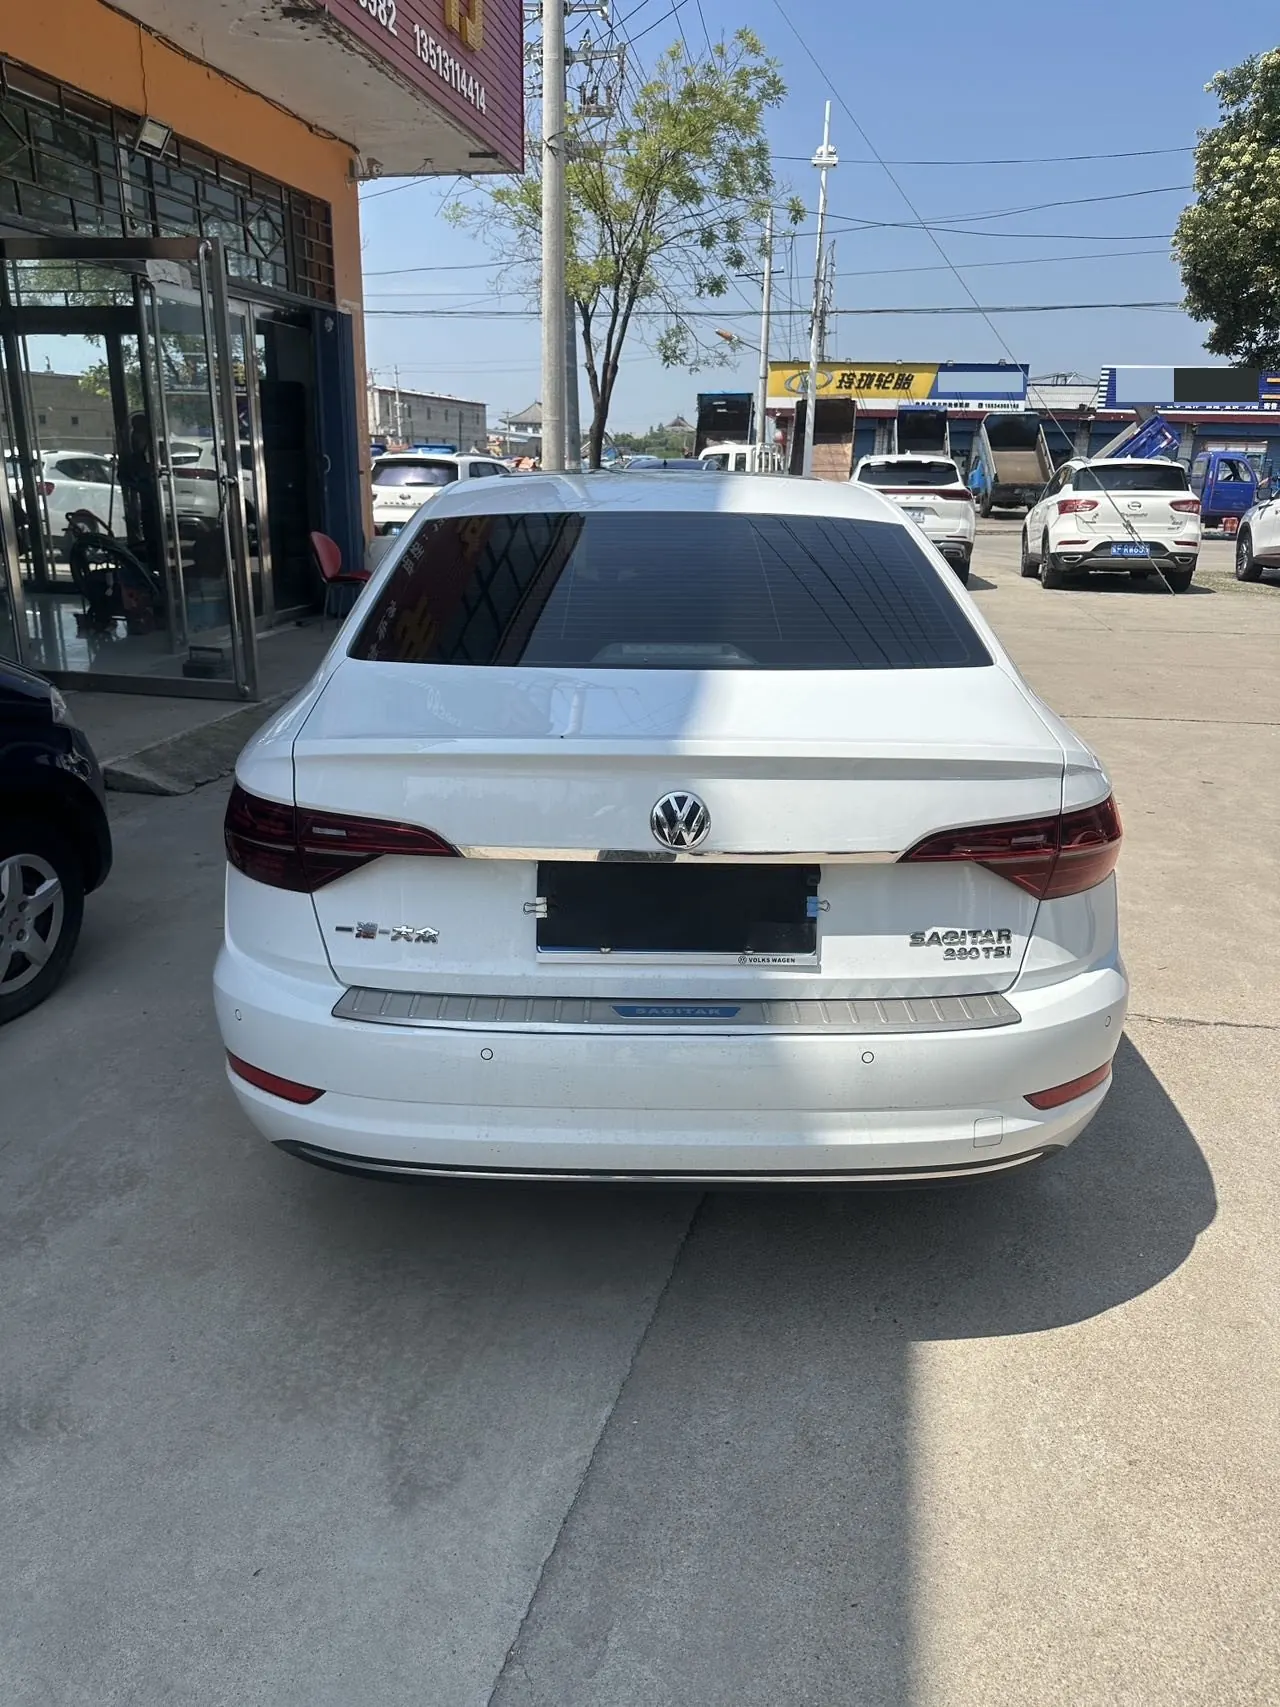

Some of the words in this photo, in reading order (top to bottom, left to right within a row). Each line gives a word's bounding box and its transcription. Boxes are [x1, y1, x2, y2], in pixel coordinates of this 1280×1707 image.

[414, 24, 486, 114] 13513114414
[909, 928, 1012, 947] SAGITAR
[635, 1007, 721, 1015] SAGITAR
